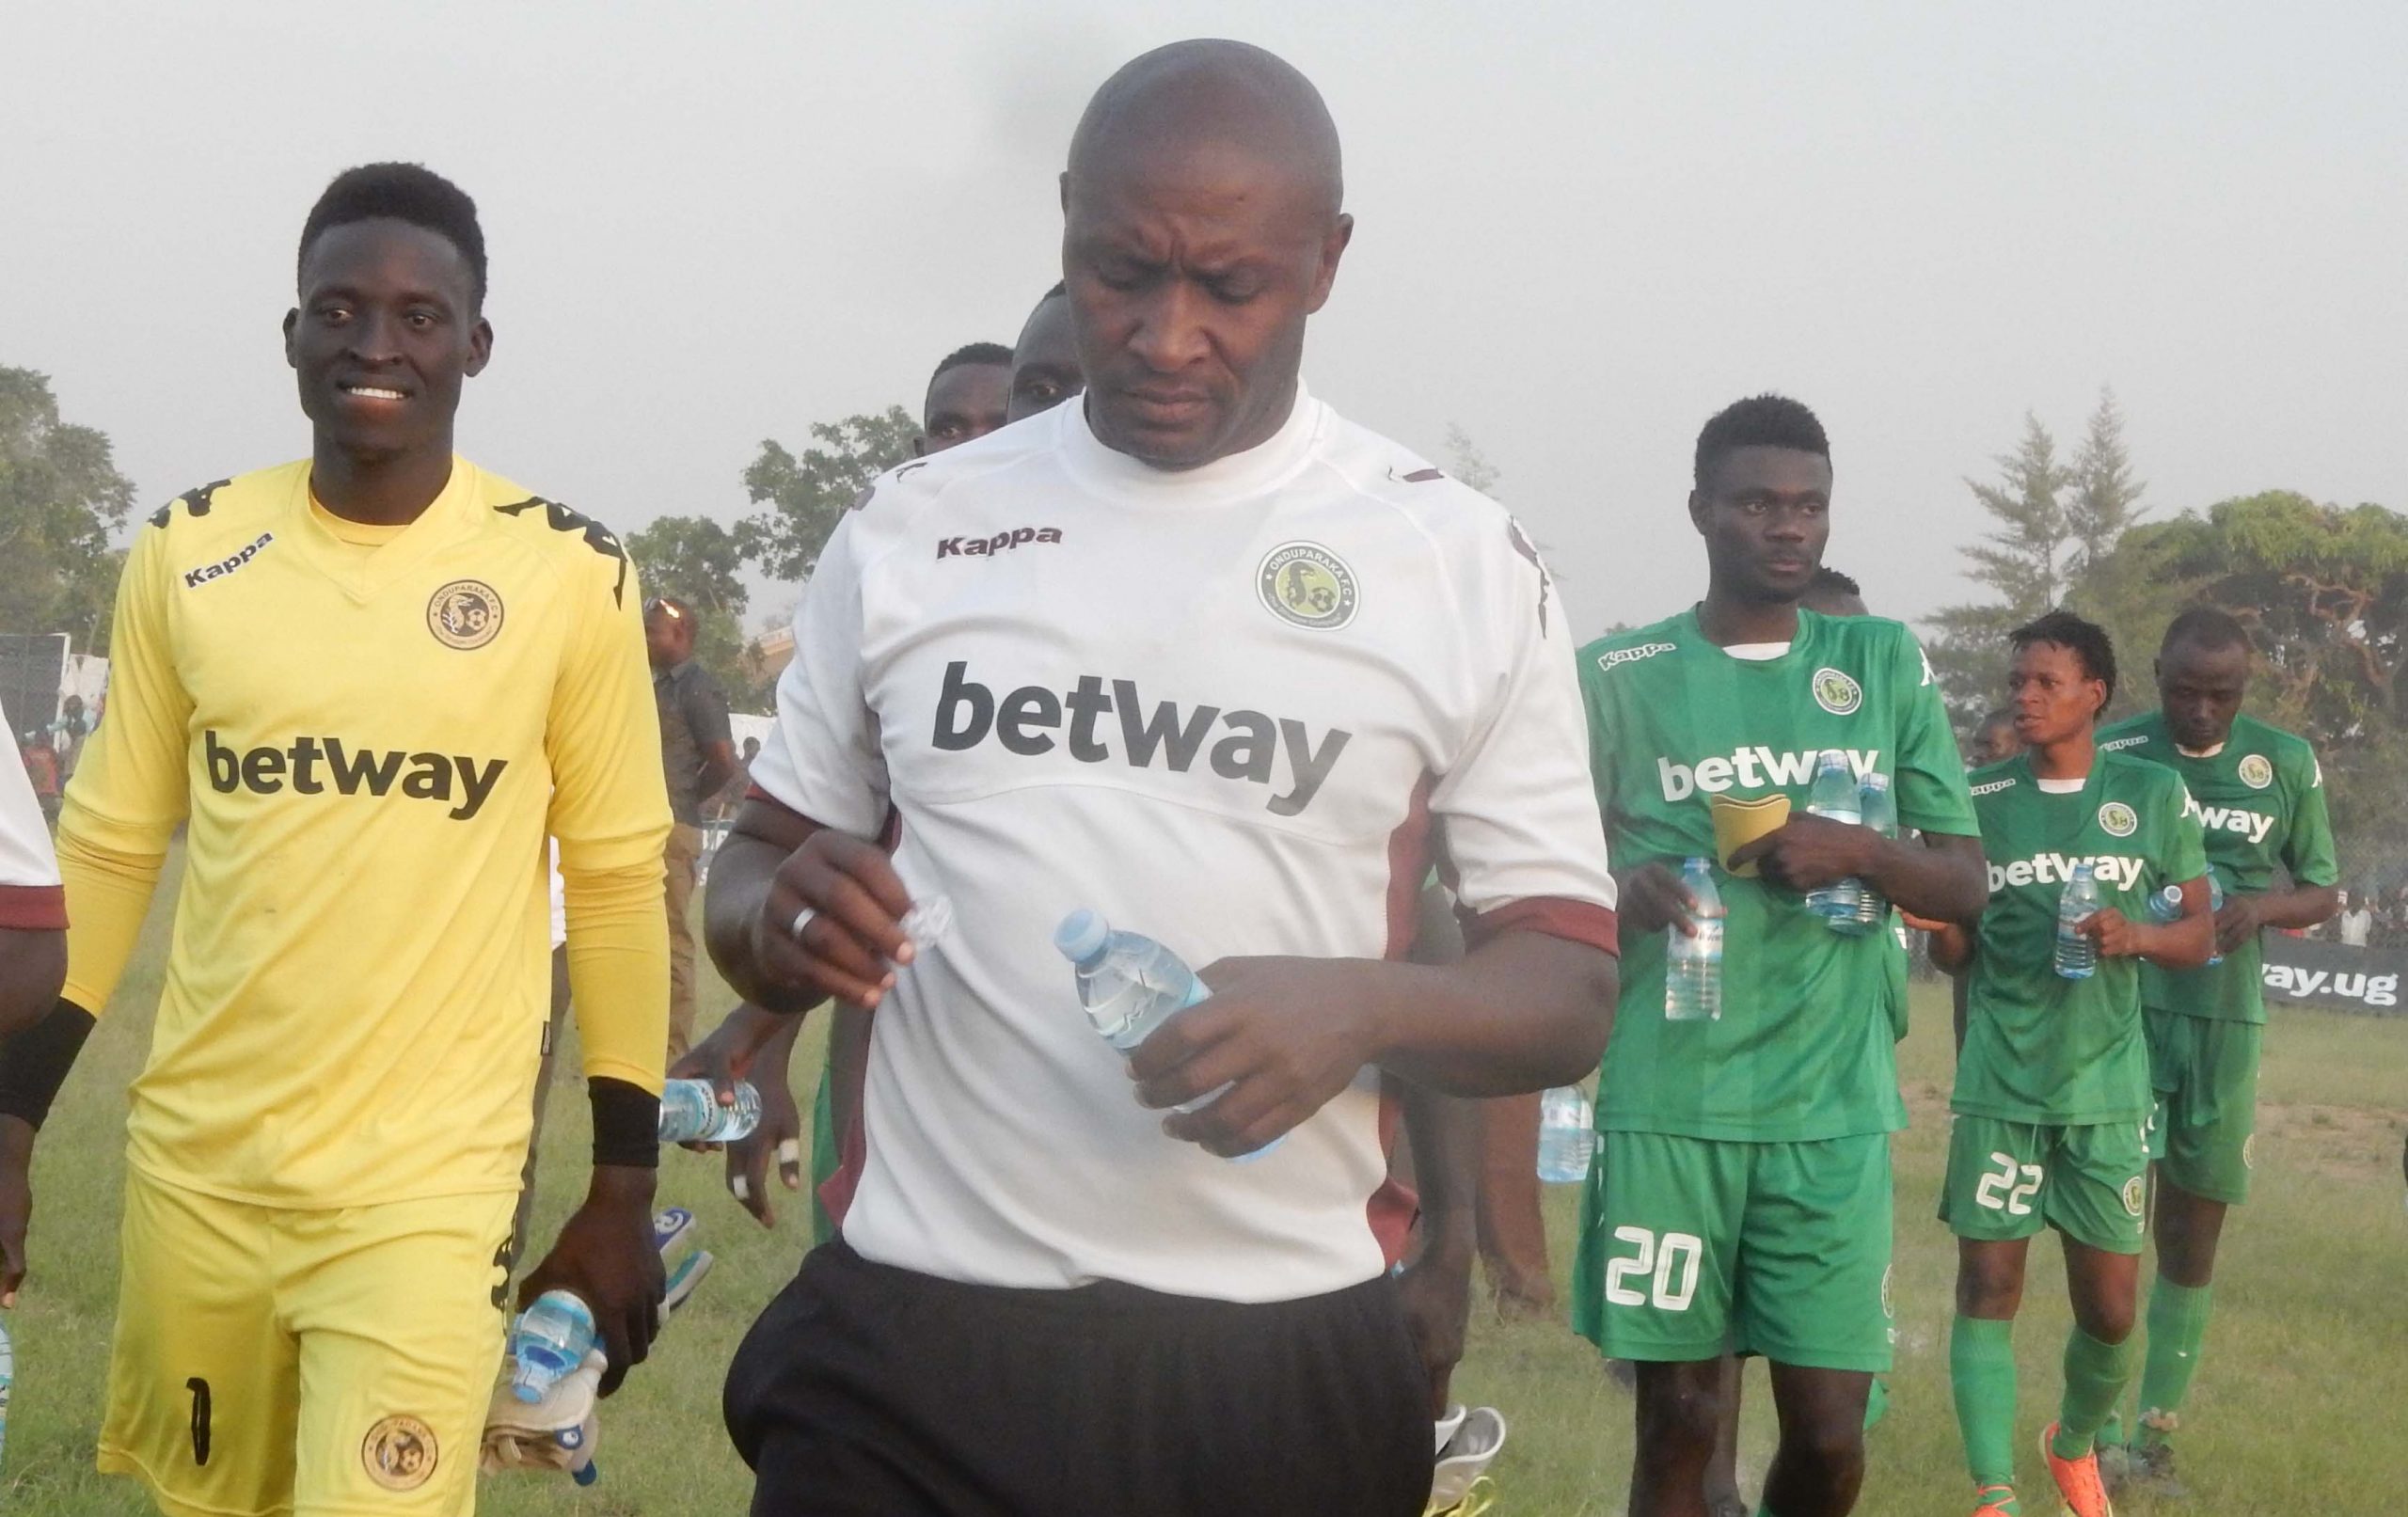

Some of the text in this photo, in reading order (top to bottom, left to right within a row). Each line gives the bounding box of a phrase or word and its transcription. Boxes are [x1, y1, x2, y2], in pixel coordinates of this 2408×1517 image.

[183, 532, 274, 589] Kappa
[937, 527, 1063, 560] Kappa
[1269, 548, 1344, 578] ONDUPARAKA
[1597, 642, 1677, 672] Kappa
[932, 660, 1353, 817] betway
[205, 730, 509, 821] betway
[1657, 746, 1879, 801] betwy
[1970, 778, 2016, 796] appa
[2261, 963, 2399, 1006] ay.ug
[1976, 1151, 2043, 1215] 22
[1606, 1225, 1703, 1311] 20
[186, 1377, 212, 1466] 1
